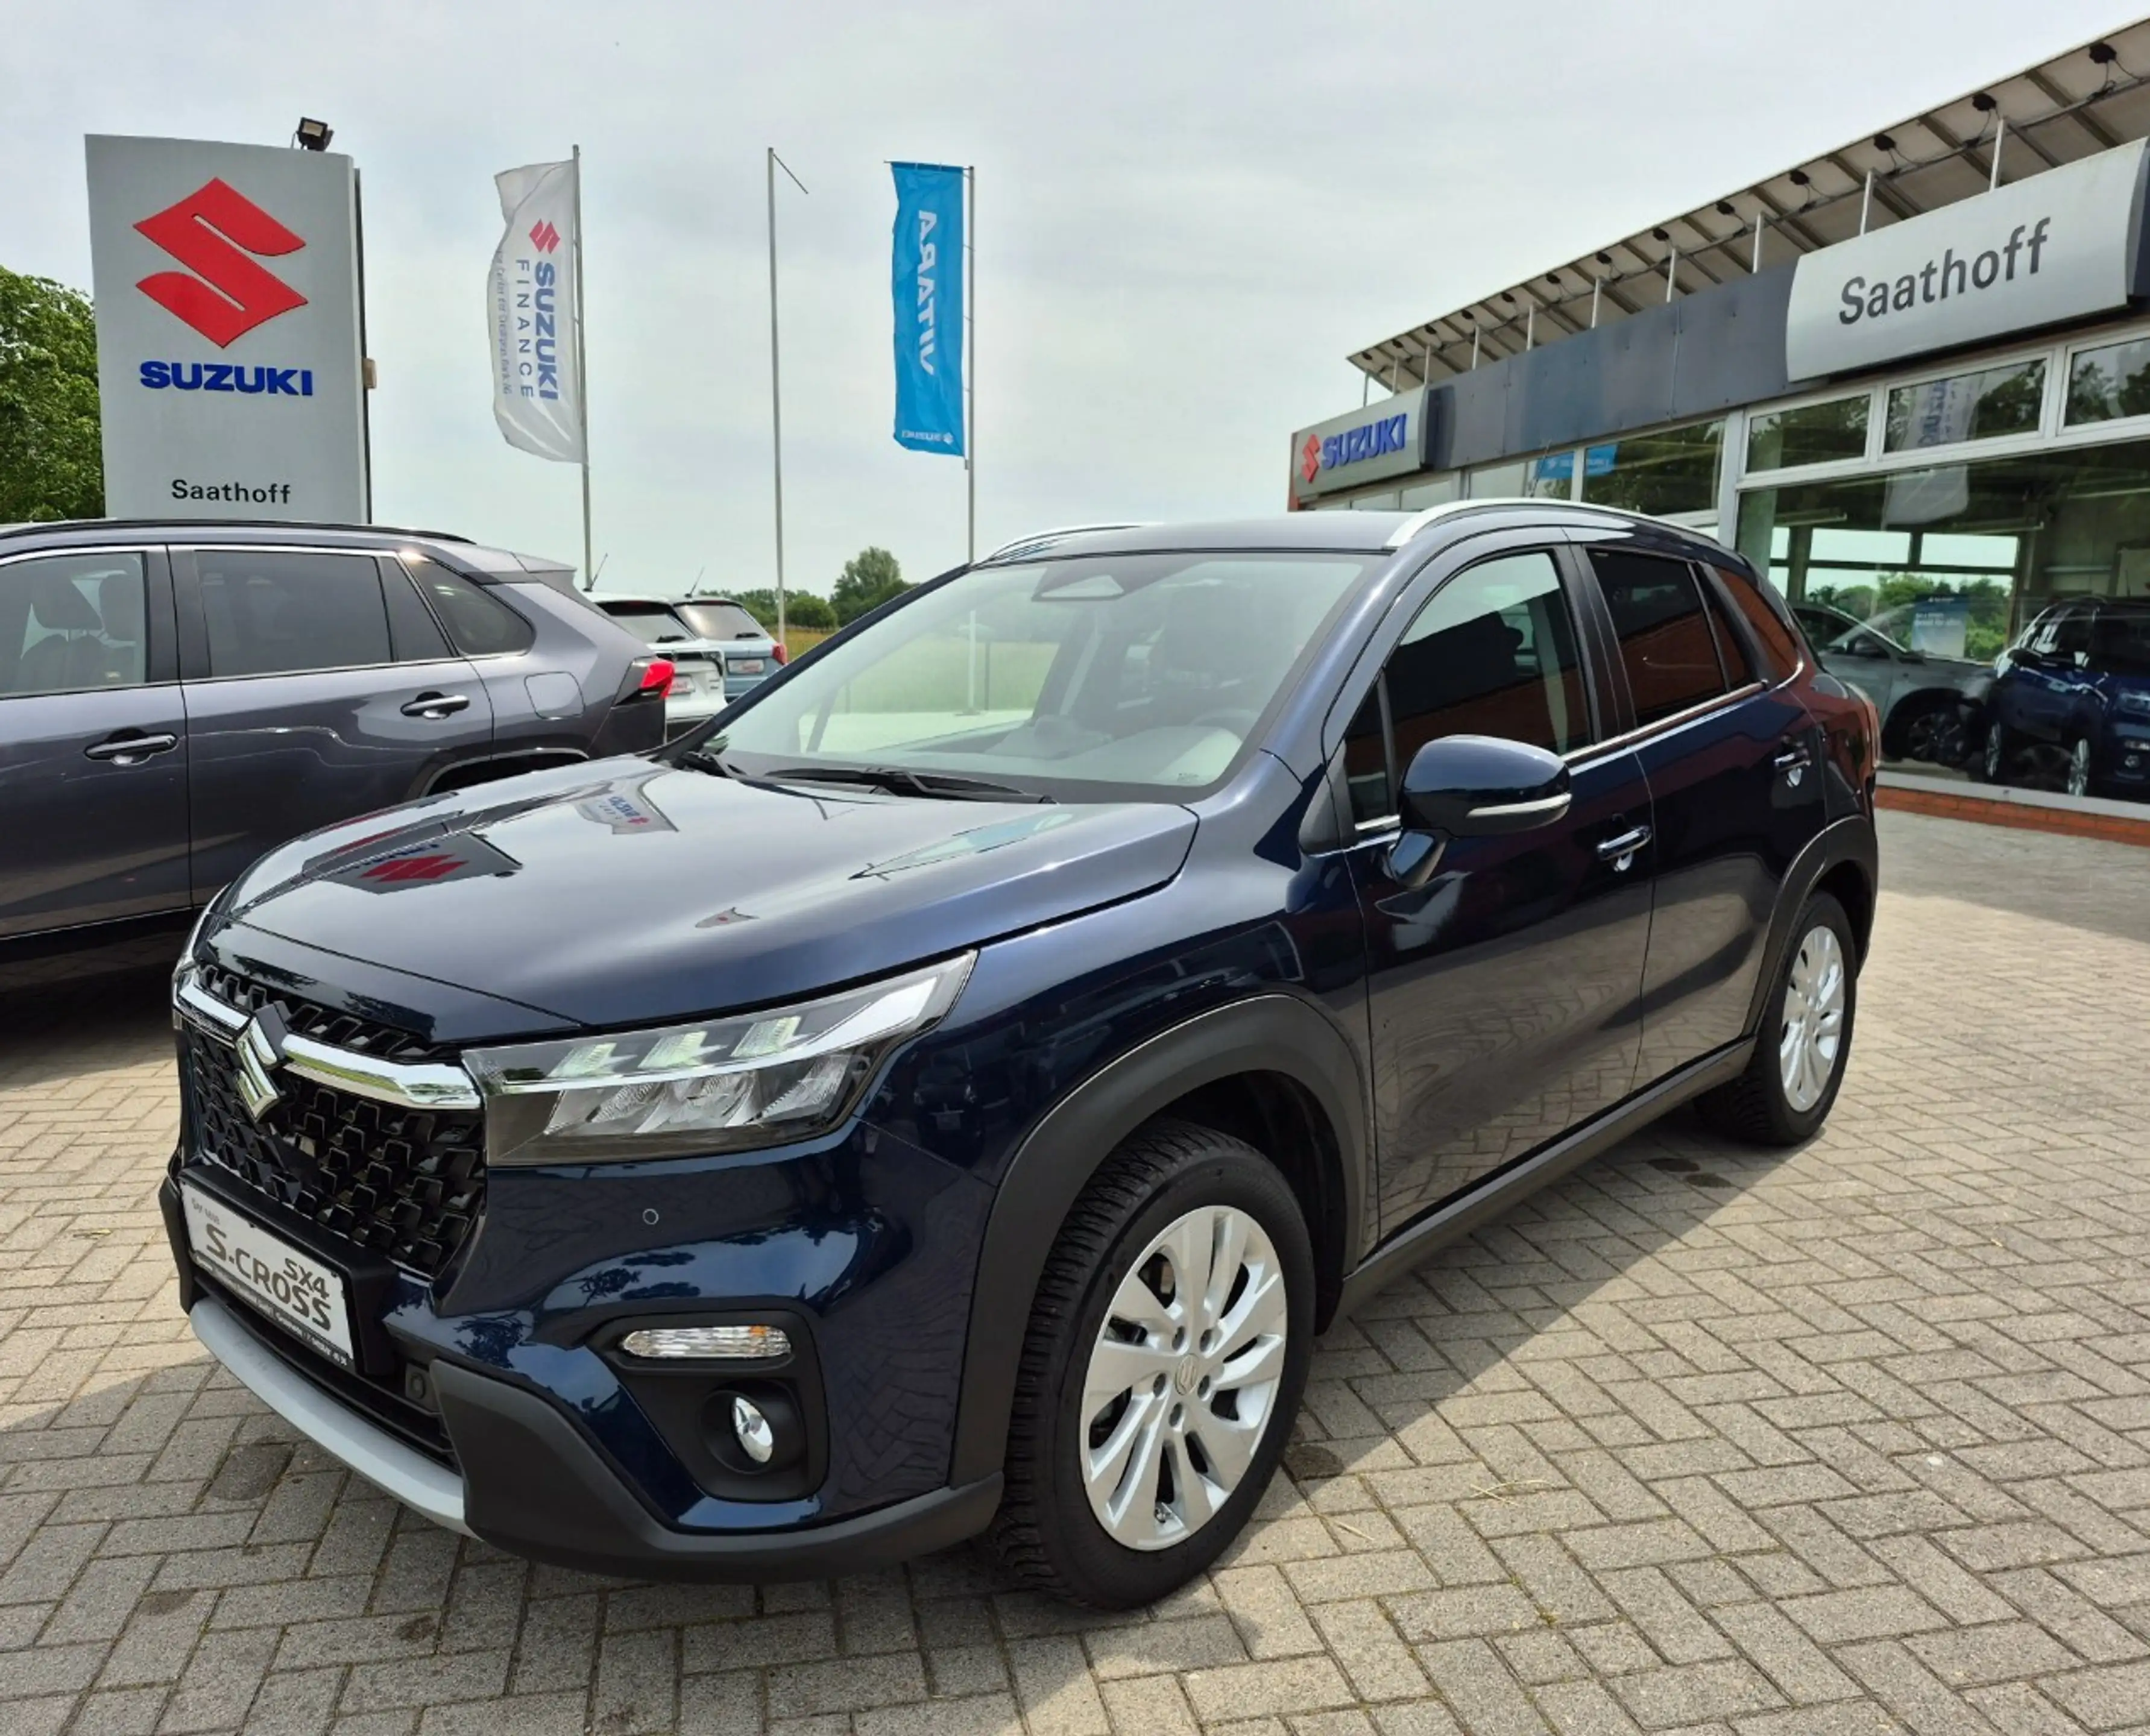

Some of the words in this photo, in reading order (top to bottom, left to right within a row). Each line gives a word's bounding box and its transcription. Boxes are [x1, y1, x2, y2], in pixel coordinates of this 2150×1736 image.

[1839, 217, 2051, 326] Saathoff
[515, 259, 534, 398] FINANCE
[534, 260, 558, 400] SUZUKI
[140, 360, 314, 397] SUZUKI
[1321, 413, 1407, 471] SUZUKI
[172, 479, 291, 505] Saathoff
[283, 1257, 330, 1300] SX4
